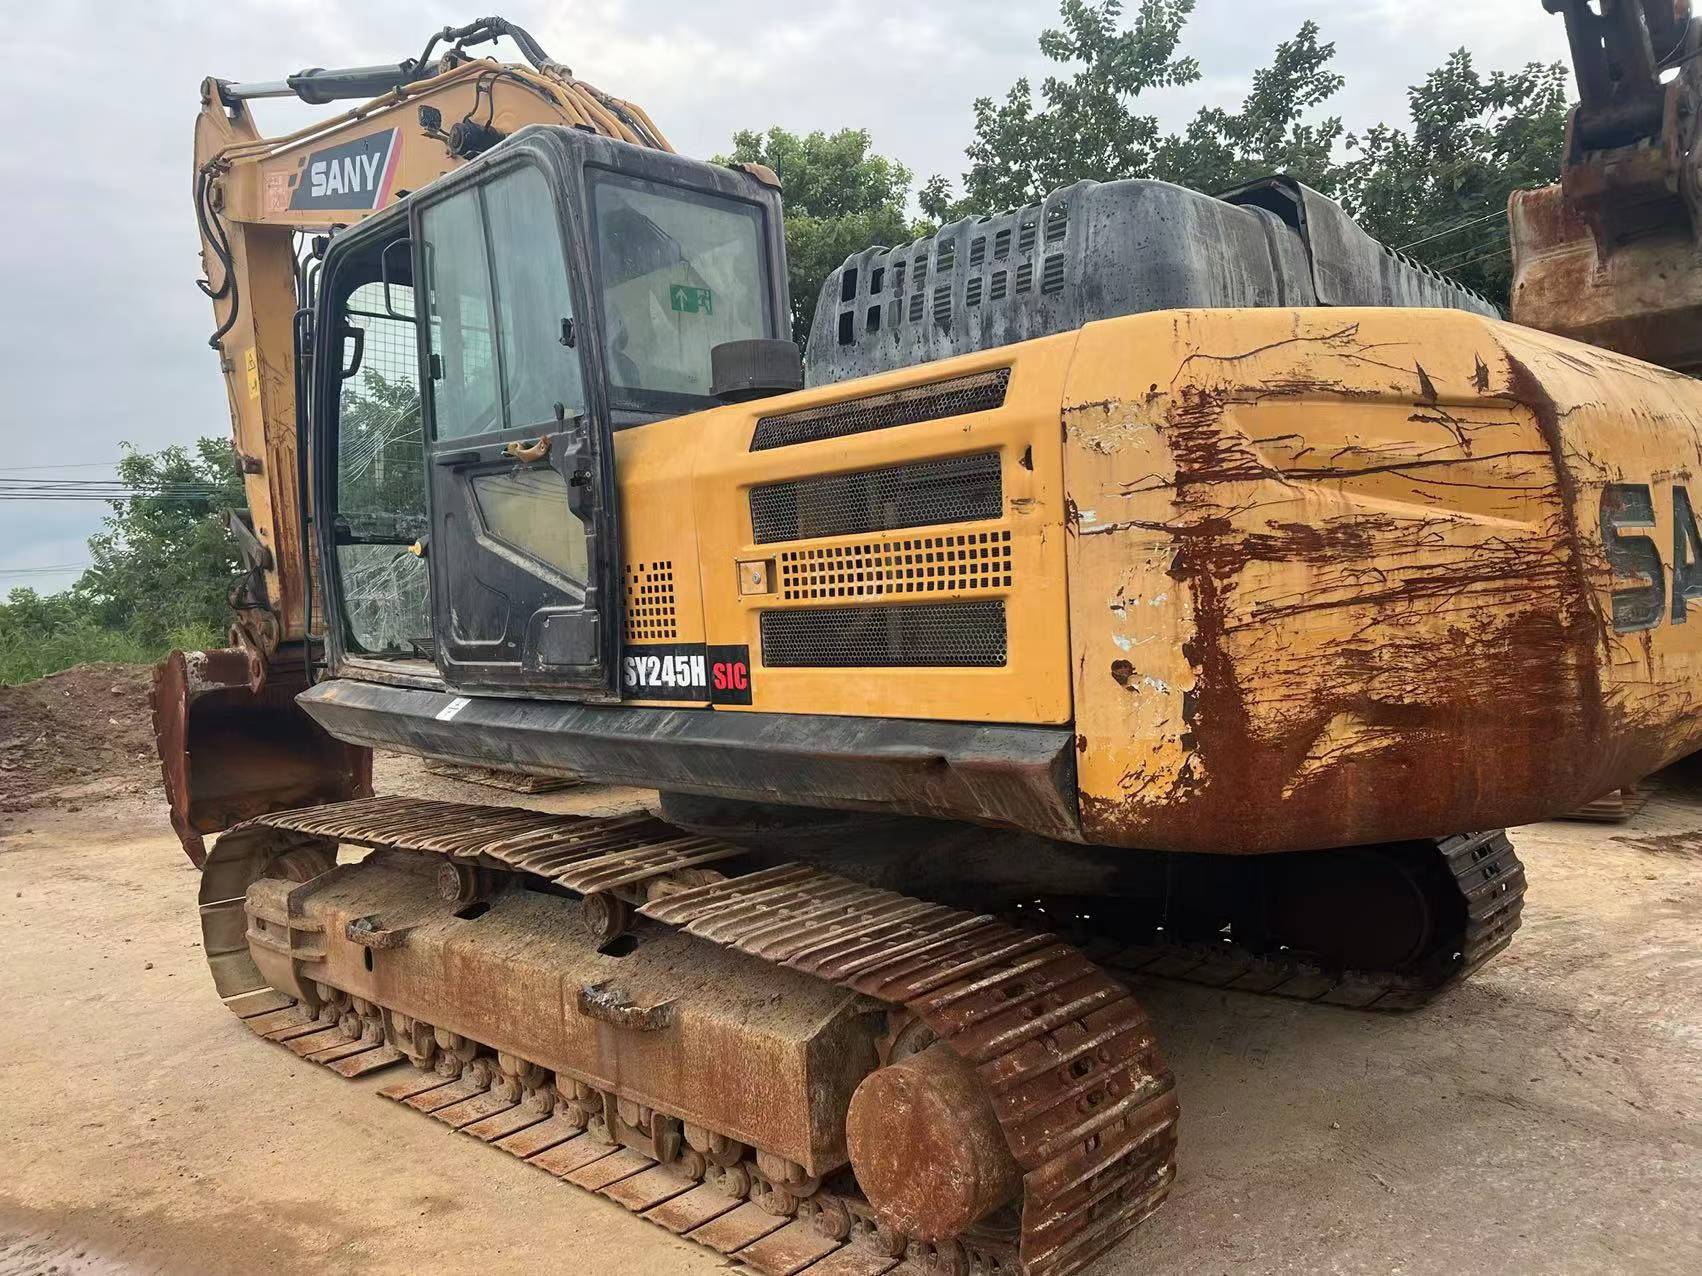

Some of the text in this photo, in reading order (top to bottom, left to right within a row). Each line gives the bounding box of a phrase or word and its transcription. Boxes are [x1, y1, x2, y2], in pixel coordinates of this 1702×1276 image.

[311, 152, 381, 197] SANY
[624, 655, 747, 690] SY245H SIC
